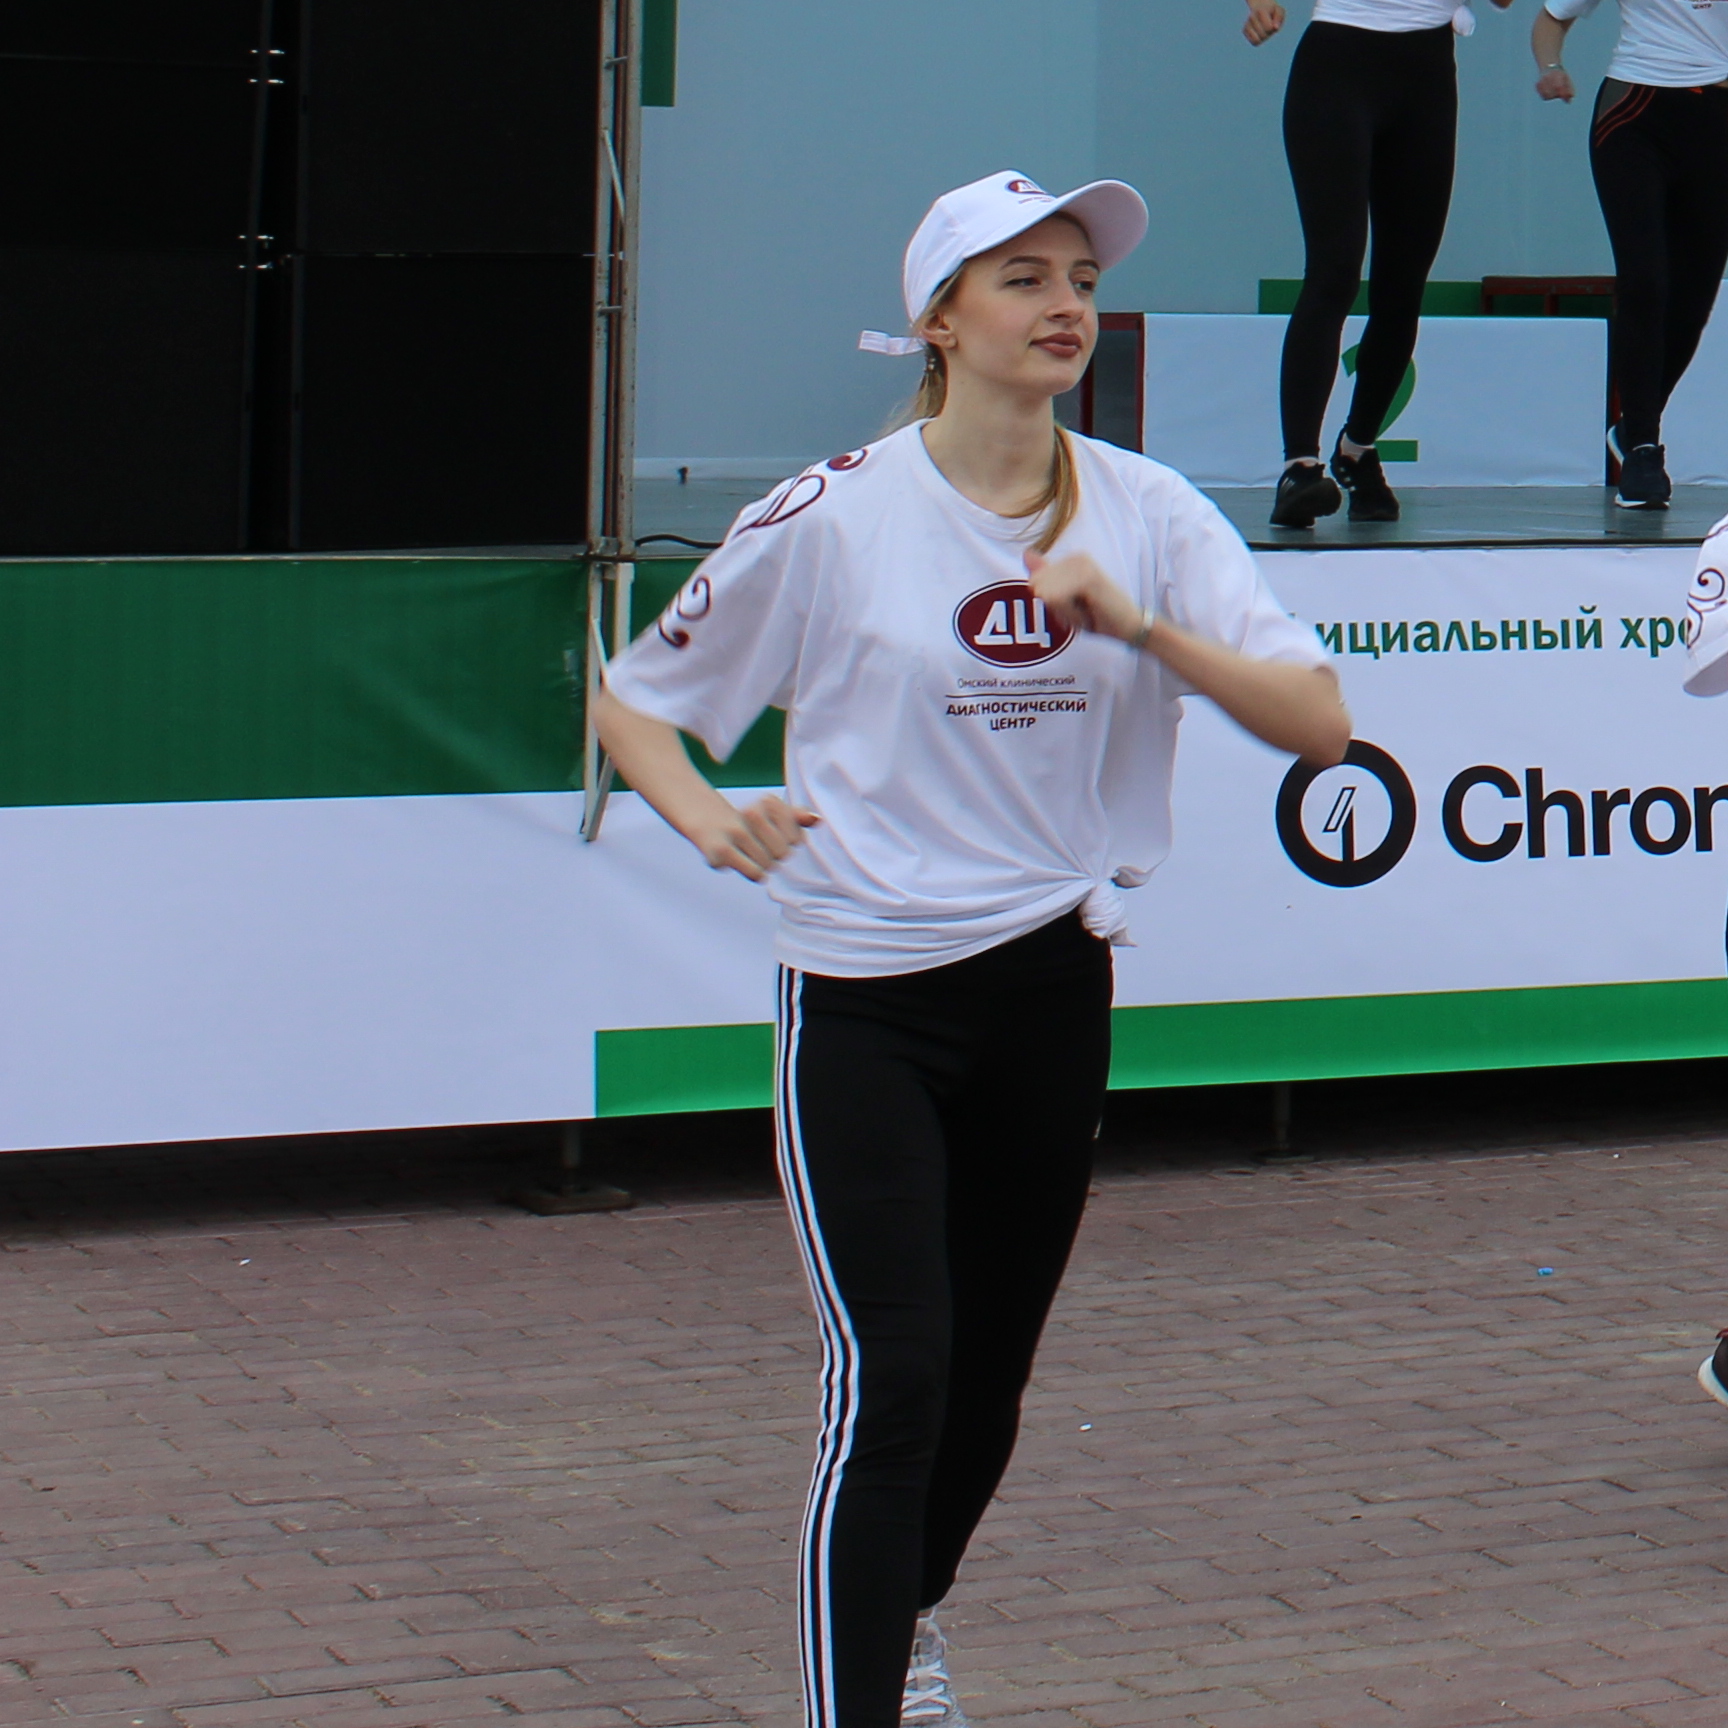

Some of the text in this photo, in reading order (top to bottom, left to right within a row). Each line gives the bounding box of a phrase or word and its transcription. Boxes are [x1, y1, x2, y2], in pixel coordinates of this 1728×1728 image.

[973, 597, 1052, 649] ДЦ
[1315, 605, 1602, 659] ициальный
[1000, 674, 1076, 688] клинический
[946, 698, 1087, 717] ДИАГНОСТИЧЕСКИЙ
[990, 716, 1037, 732] ЦЕНТР
